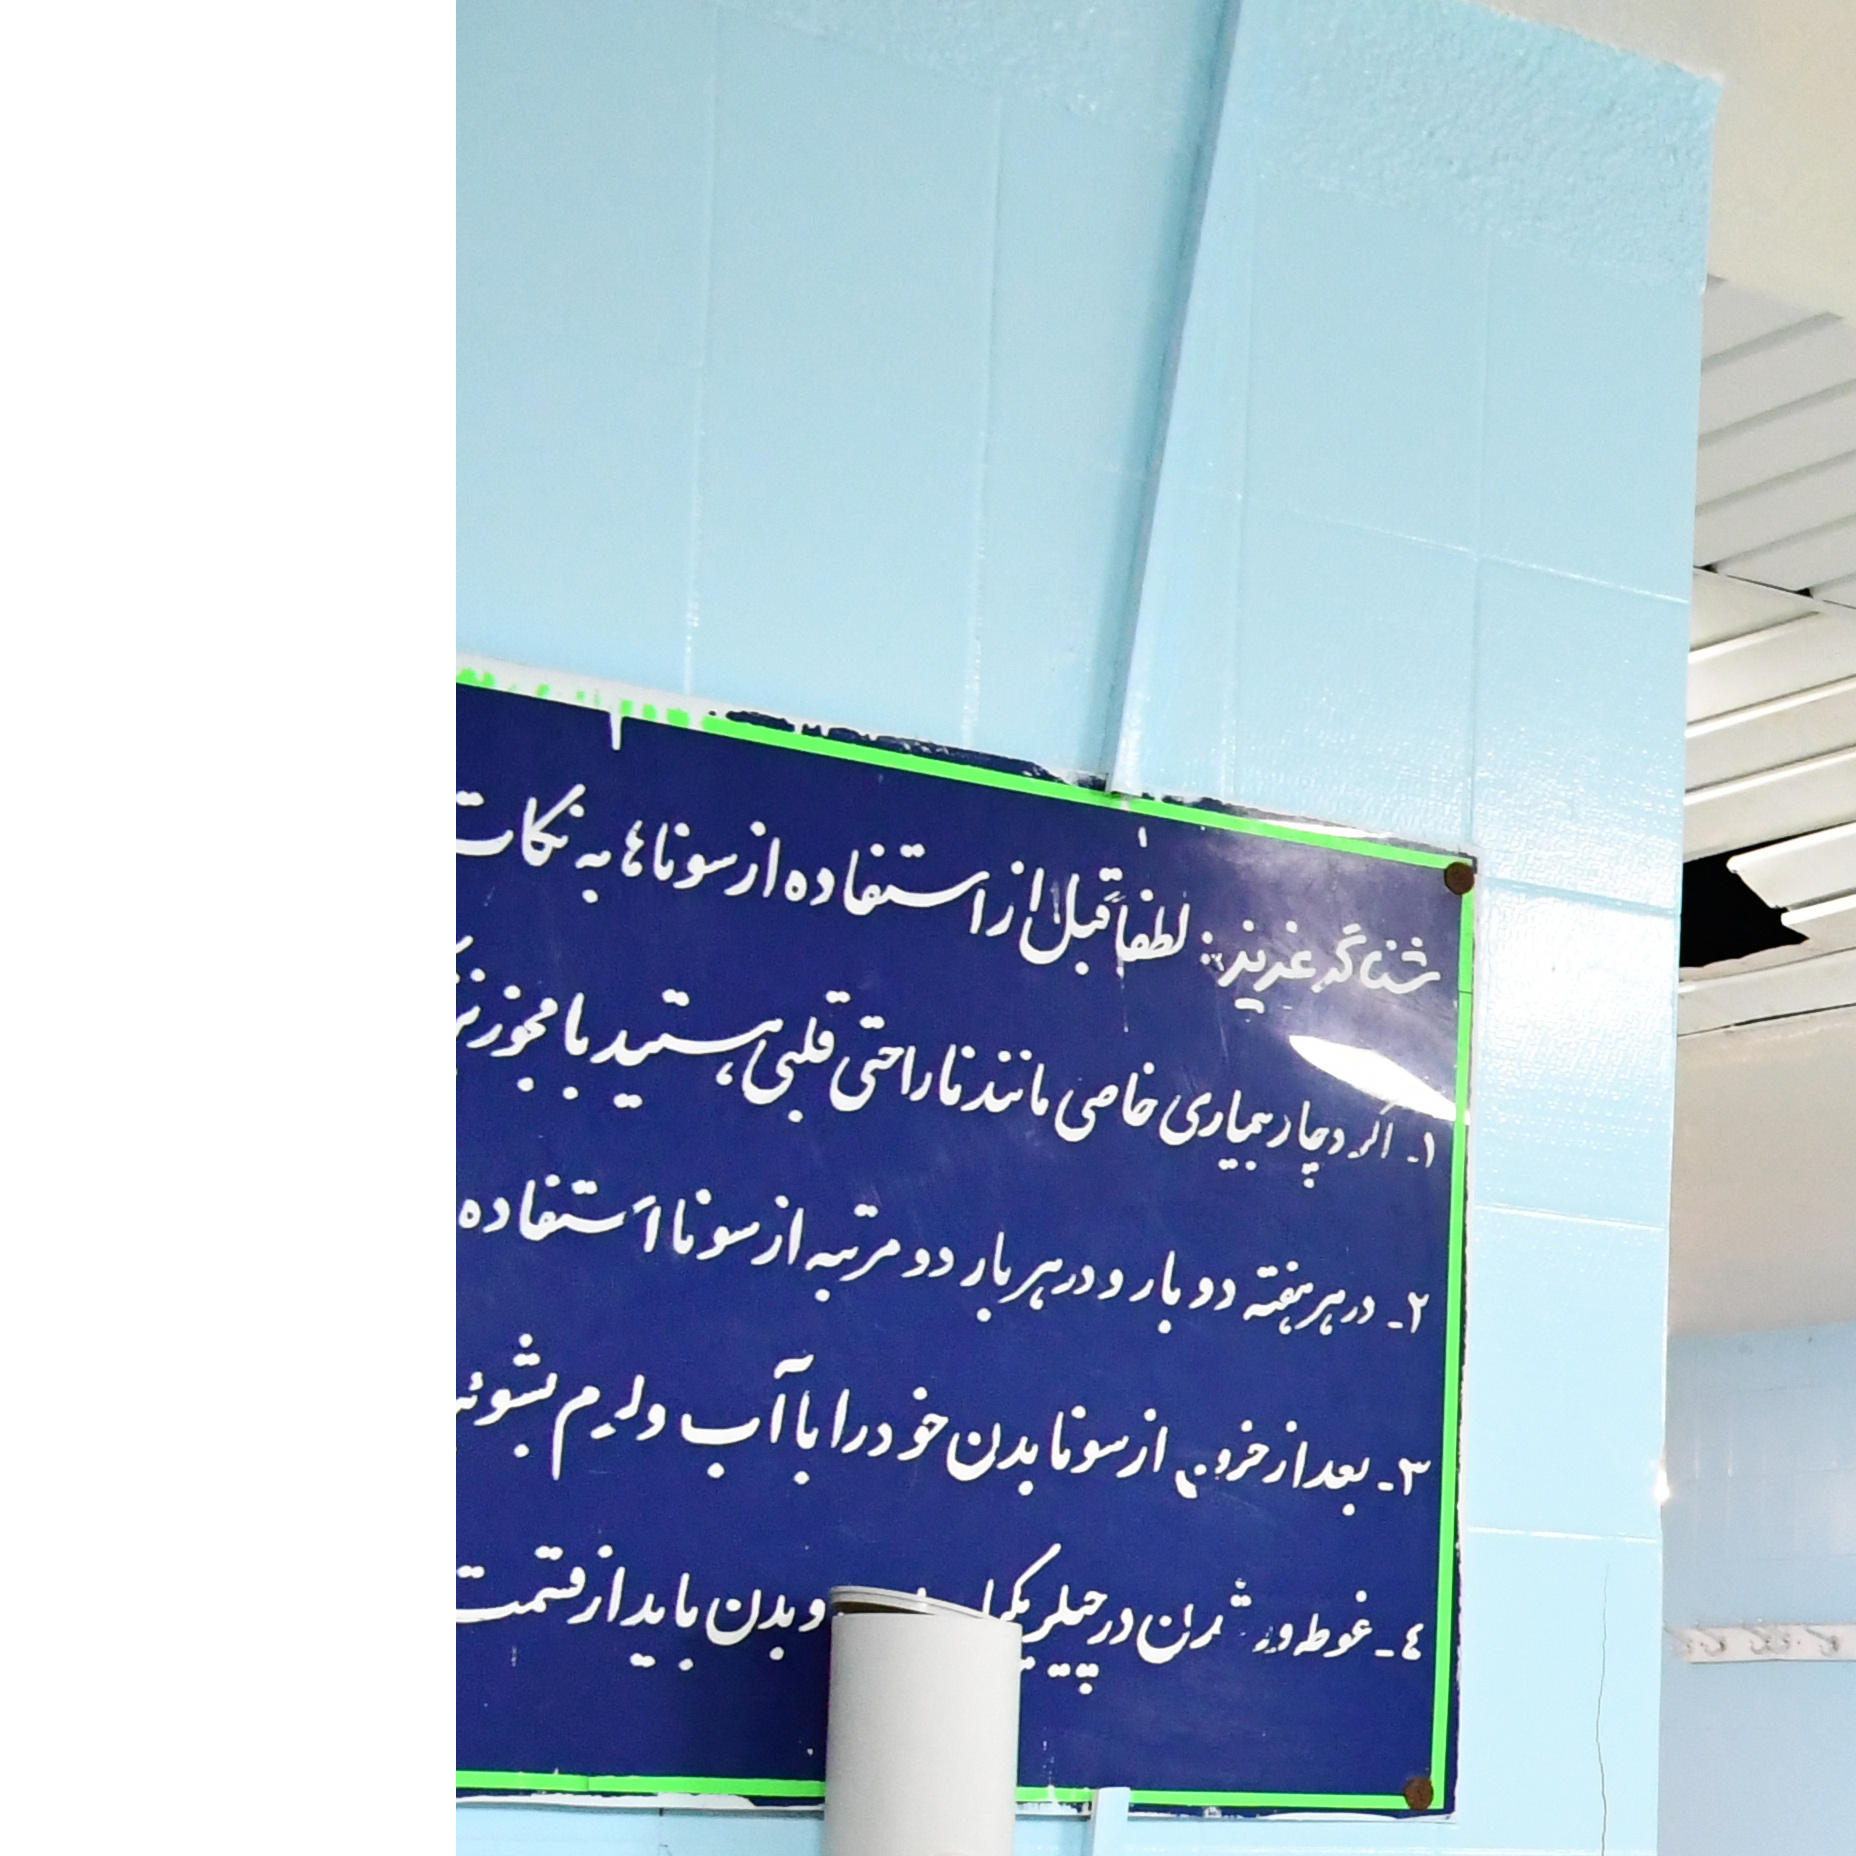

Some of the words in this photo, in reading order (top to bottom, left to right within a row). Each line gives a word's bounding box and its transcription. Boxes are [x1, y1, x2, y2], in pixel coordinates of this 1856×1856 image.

[455, 783, 586, 867] نکات
[724, 821, 781, 898] از
[575, 850, 612, 904] به
[784, 843, 990, 935] استفاده
[985, 860, 1045, 937] از
[1019, 867, 1123, 976] قبل
[1308, 923, 1441, 994] شناگر
[466, 985, 558, 1092] مجوز
[562, 992, 589, 1100] با
[589, 988, 784, 1109] هستید
[741, 990, 851, 1123] قلبی
[829, 1015, 976, 1112] ناراحتی
[960, 1049, 1050, 1116] مانند
[1054, 1061, 1159, 1143] خاصی
[1158, 1089, 1274, 1171] بیماری
[1265, 1100, 1345, 1189] دچار
[1347, 1100, 1396, 1159] اگر
[458, 1174, 662, 1253] استفاده
[672, 1188, 760, 1261] سونا
[750, 1195, 804, 1266] از
[804, 1203, 901, 1302] مرتبه
[901, 1246, 955, 1278] دو
[959, 1231, 1012, 1322] بار
[998, 1258, 1063, 1310] هر
[1050, 1264, 1095, 1295] در
[1097, 1268, 1124, 1300] و
[1128, 1250, 1181, 1334] بار
[1188, 1276, 1237, 1311] دو
[1242, 1260, 1314, 1335] هفته
[1294, 1289, 1346, 1336] هر
[1340, 1295, 1376, 1325] در
[680, 1354, 814, 1479] آب
[793, 1390, 819, 1485] با
[830, 1388, 869, 1454] را
[867, 1386, 949, 1461] خود
[1050, 1405, 1130, 1474] سونا
[1115, 1408, 1168, 1479] از
[946, 1422, 1039, 1496] بدن
[1261, 1420, 1308, 1489] از
[1301, 1457, 1370, 1516] بعد
[566, 1544, 626, 1625] از
[619, 1572, 699, 1671] باید
[798, 1598, 826, 1632] و
[705, 1589, 795, 1661] بدن
[1022, 1584, 1108, 1695] چیلر
[1086, 1607, 1134, 1645] در
